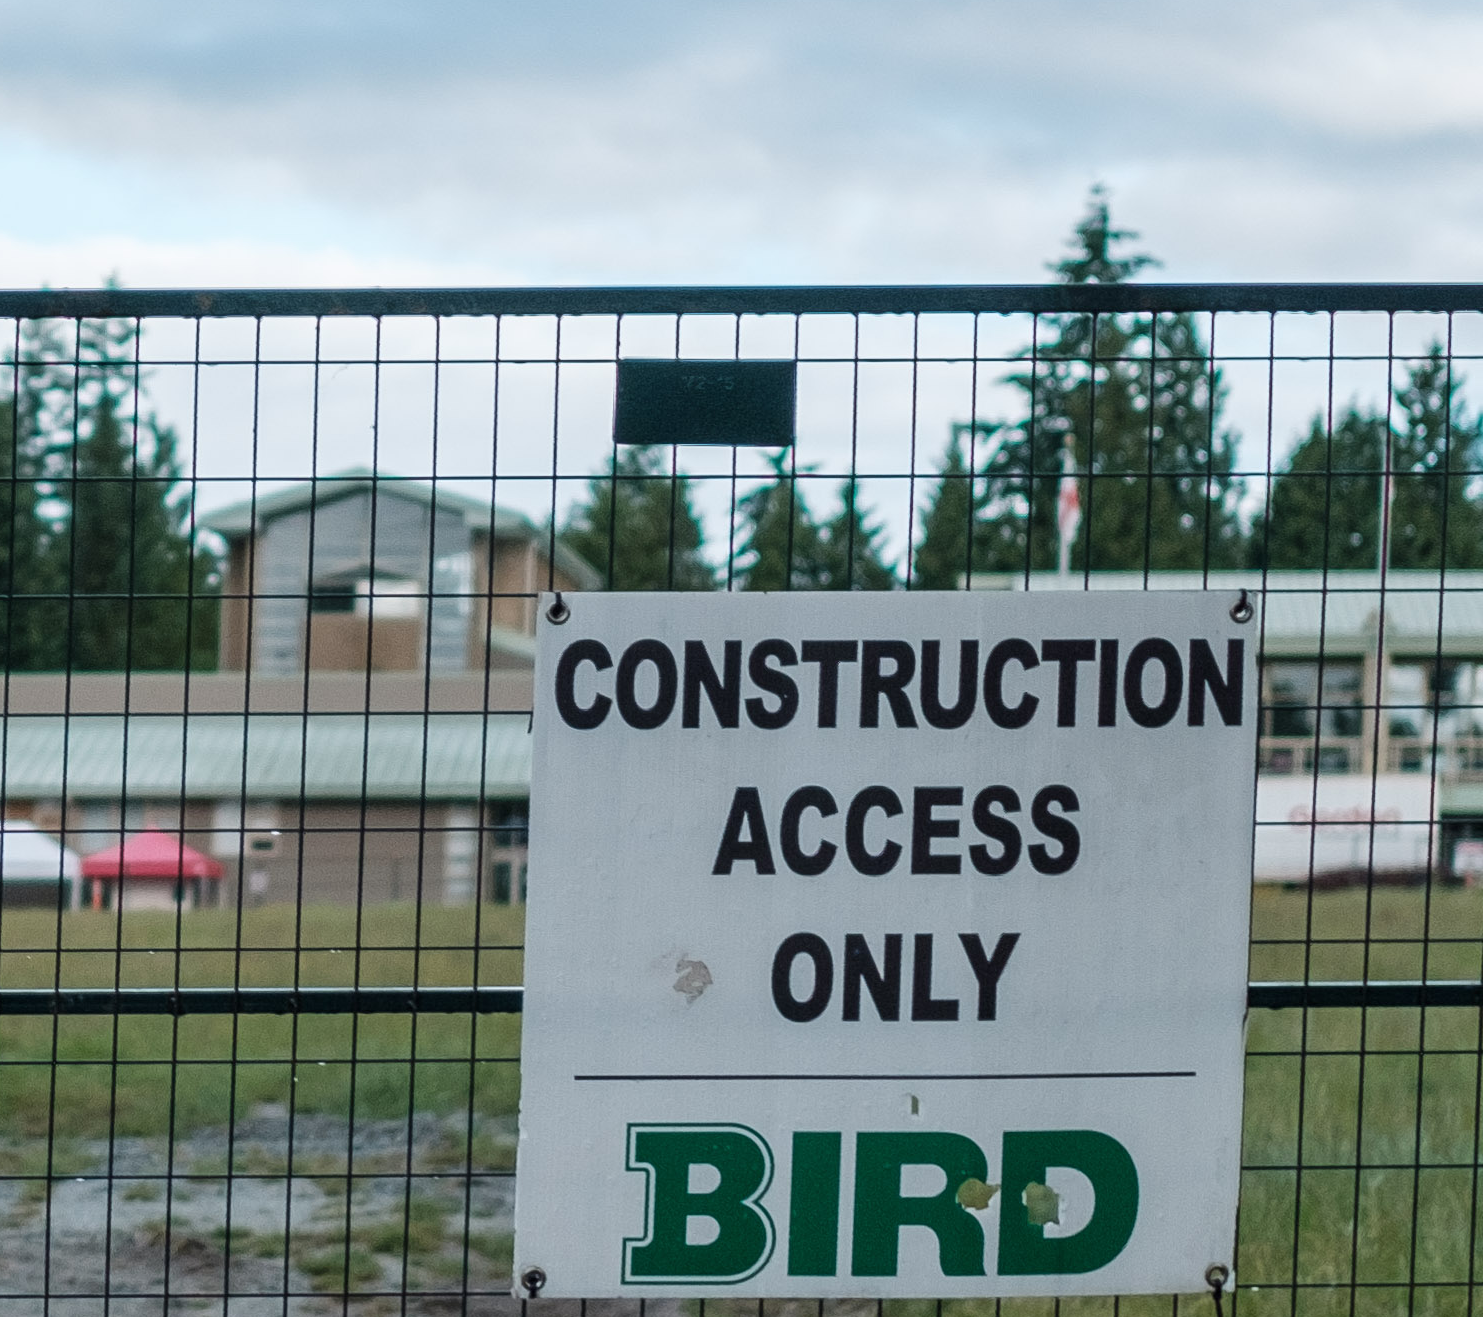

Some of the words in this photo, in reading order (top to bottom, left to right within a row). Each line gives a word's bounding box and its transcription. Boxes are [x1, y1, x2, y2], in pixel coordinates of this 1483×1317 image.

[554, 638, 1244, 729] CONSTRUCTION
[713, 785, 1080, 876] ACCESS
[771, 932, 1020, 1023] ONLY
[621, 1122, 1139, 1285] BIRD
